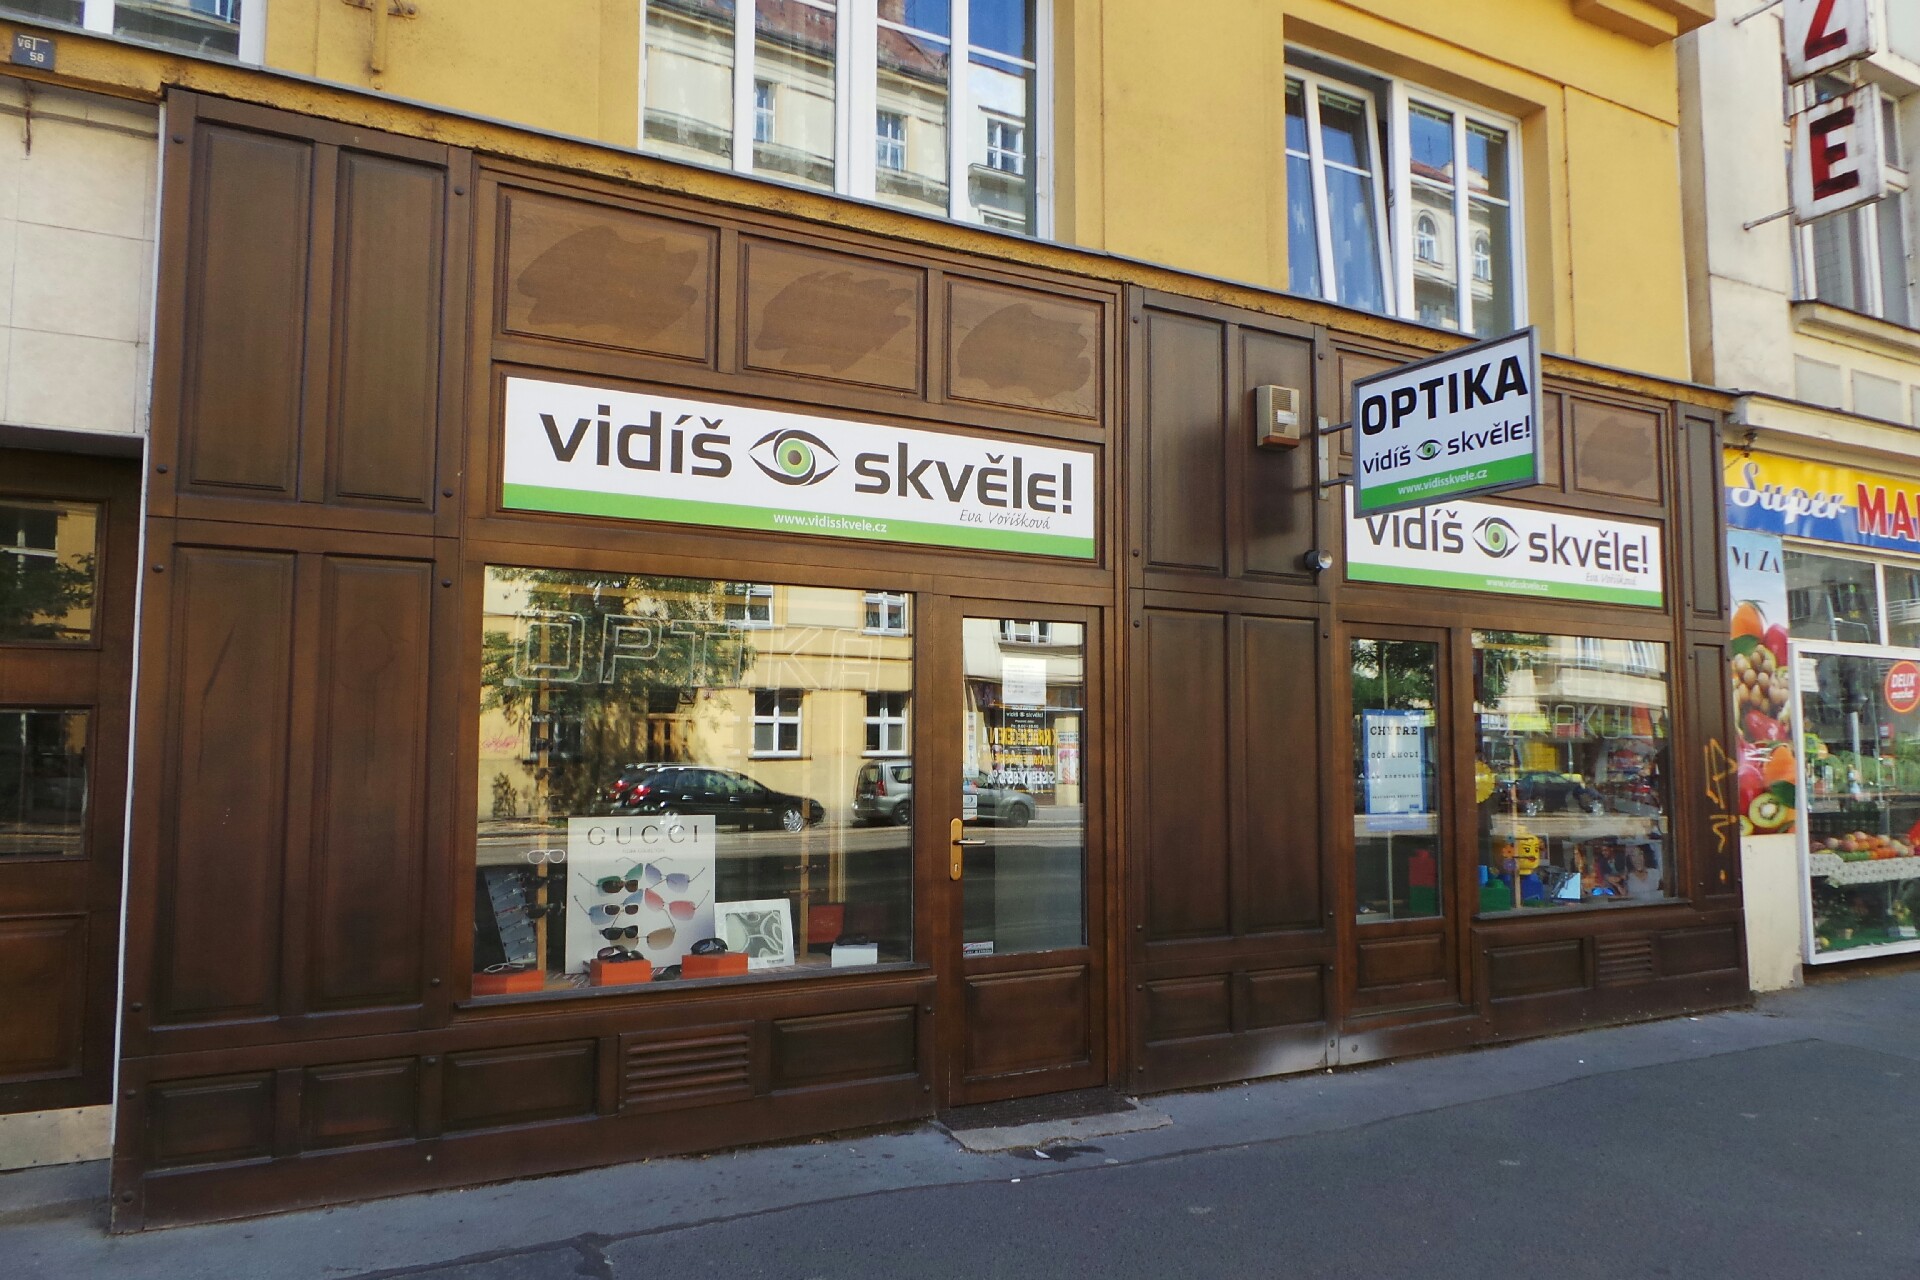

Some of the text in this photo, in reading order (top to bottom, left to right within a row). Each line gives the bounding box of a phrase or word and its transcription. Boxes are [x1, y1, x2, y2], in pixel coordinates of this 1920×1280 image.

[29, 51, 44, 62] 58
[1361, 355, 1528, 435] OPTIKA
[539, 404, 1073, 514] vidíš skvěle!
[1363, 415, 1531, 475] vidíš skvěle!
[1397, 467, 1488, 495] www.vidisskvele.cz
[1731, 462, 1920, 542] Super MA
[773, 512, 888, 534] www.vidisskvele.cz
[959, 508, 1051, 531] Eva Voříšková
[1365, 506, 1649, 575] vidíš skvěle!
[513, 610, 881, 692] OPTIKA
[587, 825, 698, 846] GUCCI
